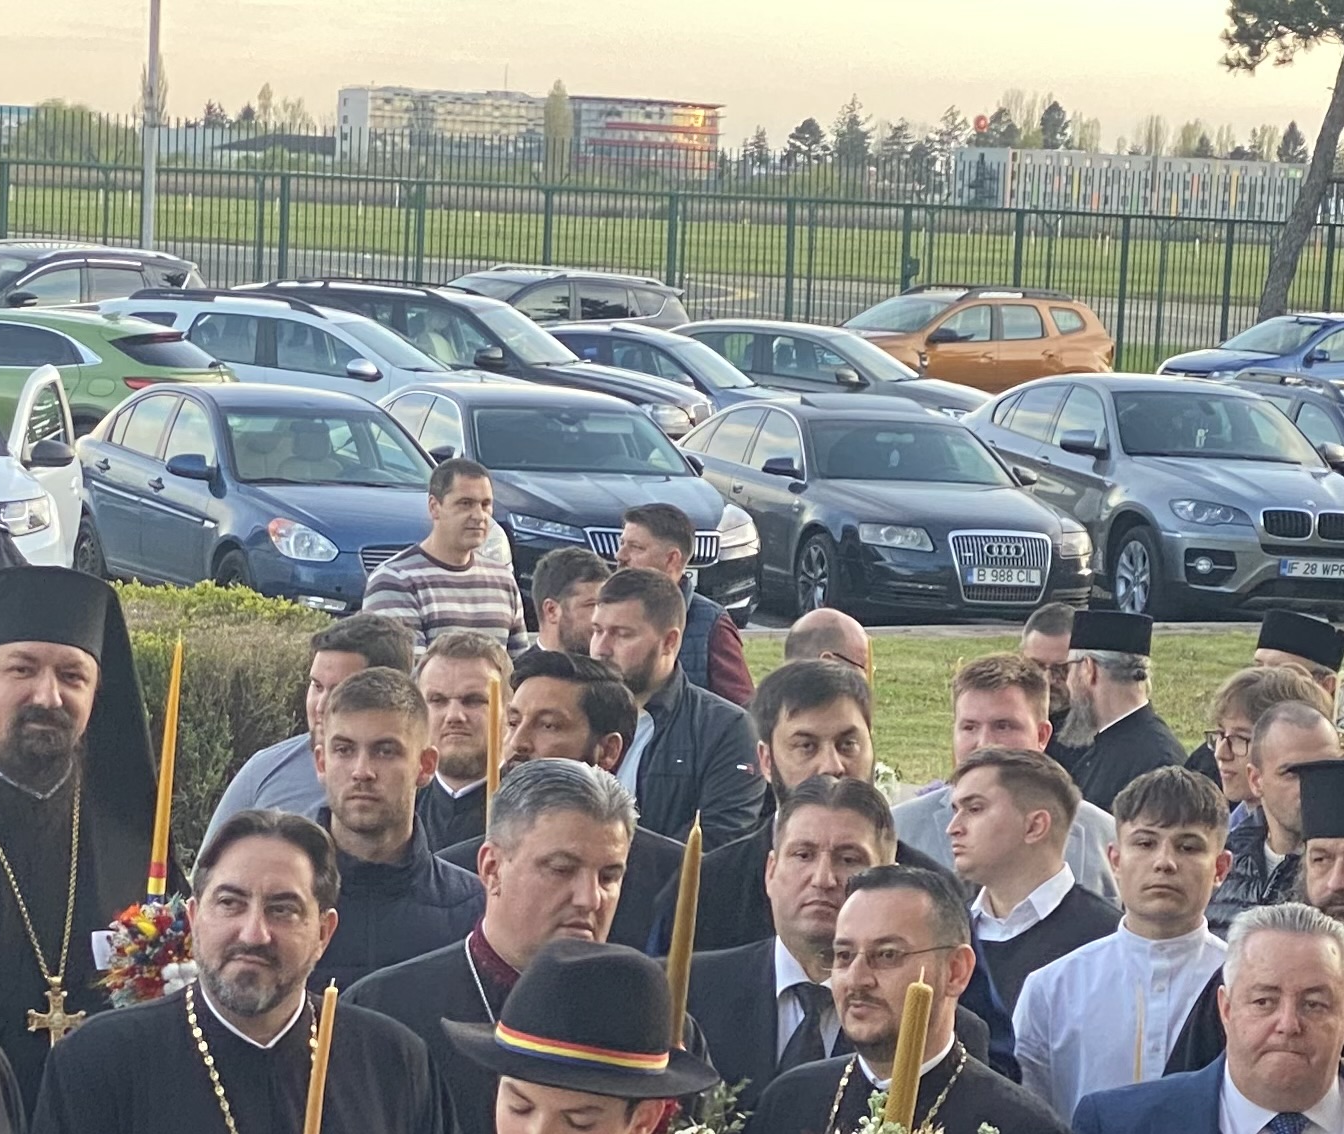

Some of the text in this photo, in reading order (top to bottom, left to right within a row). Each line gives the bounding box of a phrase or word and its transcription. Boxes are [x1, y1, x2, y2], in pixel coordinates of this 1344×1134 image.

[1288, 562, 1299, 574] IF
[1303, 562, 1318, 575] 28
[977, 569, 1036, 584] B 988 CIL
